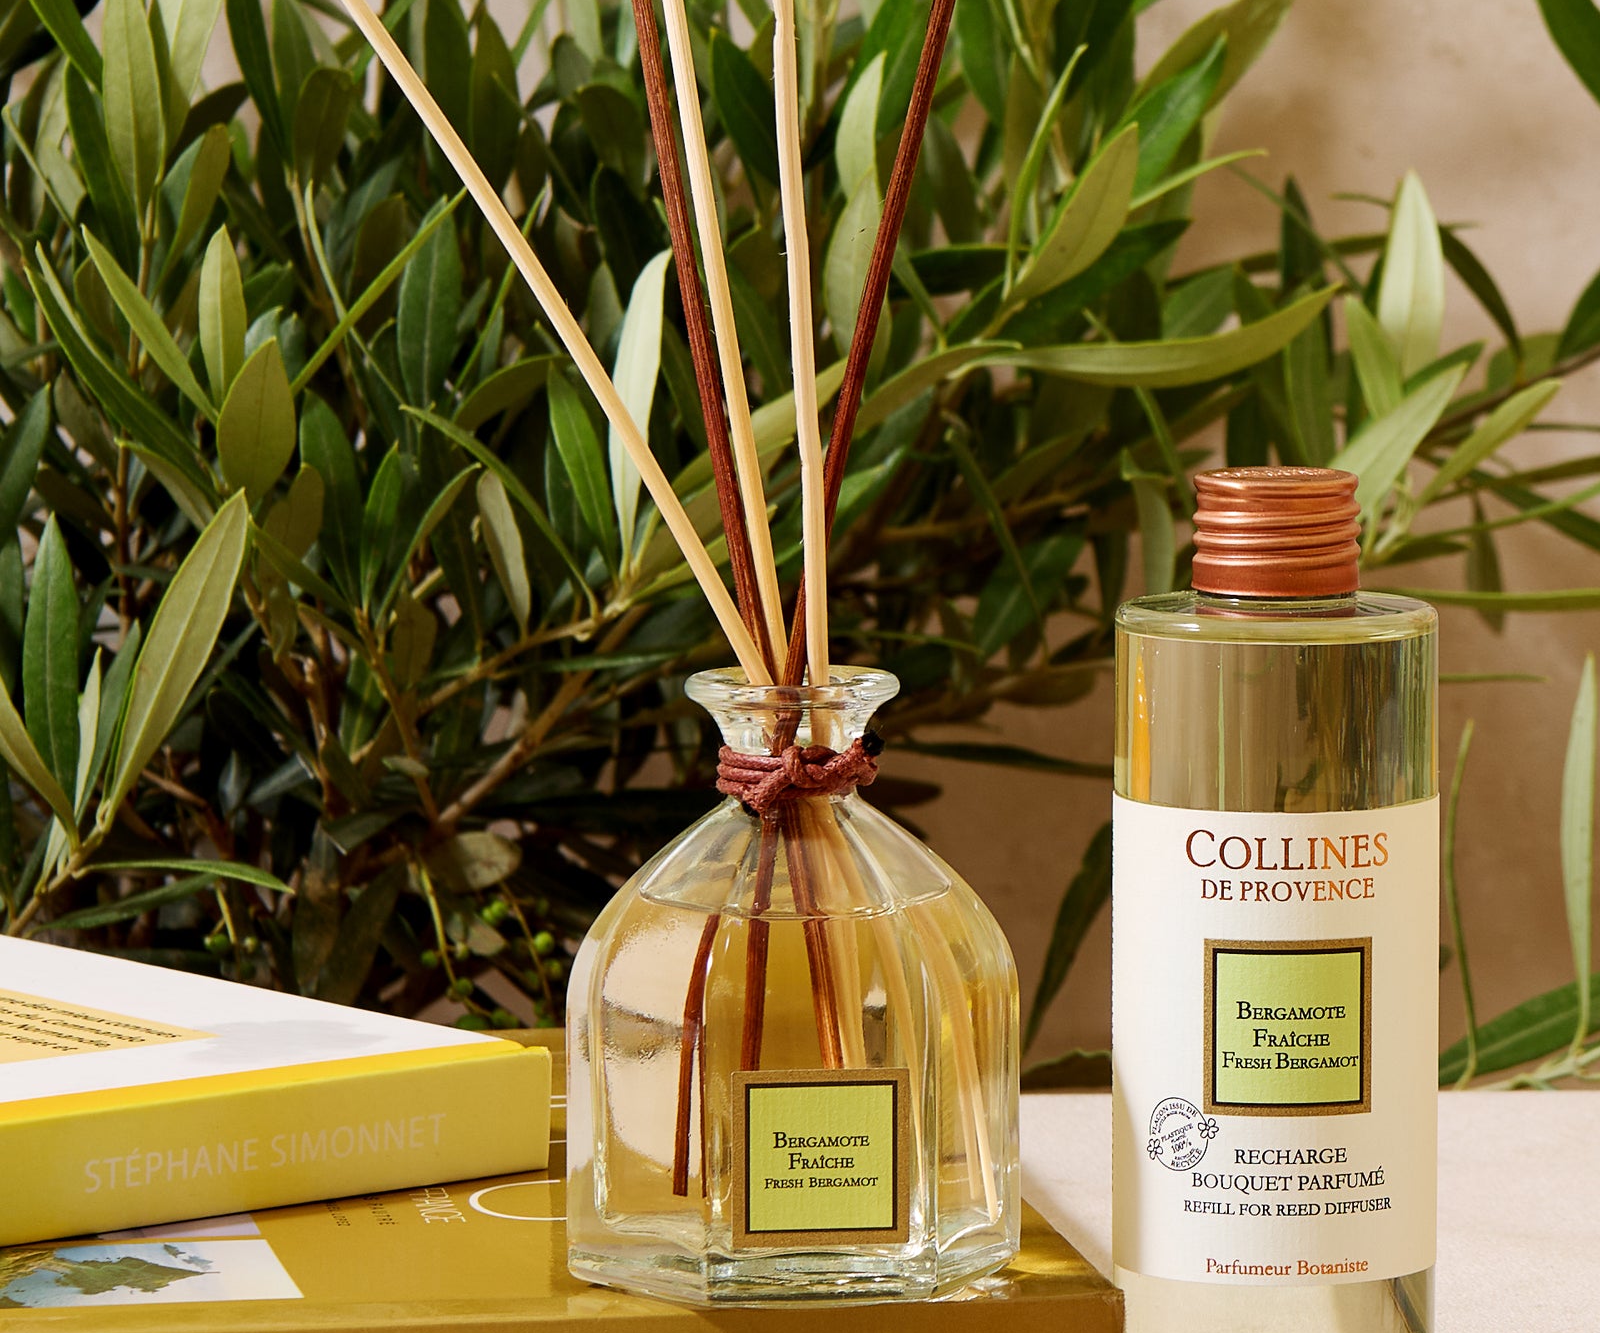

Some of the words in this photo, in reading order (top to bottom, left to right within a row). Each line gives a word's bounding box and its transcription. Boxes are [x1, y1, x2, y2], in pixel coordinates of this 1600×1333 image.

[1185, 829, 1389, 870] COLLINES
[1201, 878, 1233, 901] DE
[1240, 877, 1375, 902] PROVENCE
[1236, 1000, 1346, 1021] BERGAMOTE
[1222, 1051, 1272, 1070] FRESH
[1275, 1052, 1359, 1070] BERGAMOT
[772, 1131, 870, 1149] BERGAMOTE
[84, 1138, 260, 1193] STÉPHANE
[270, 1113, 447, 1167] SIMONNET
[1234, 1147, 1347, 1165] RECHARGE
[764, 1178, 804, 1189] FRESH
[809, 1177, 878, 1188] BERGAMOT
[1191, 1171, 1293, 1194] BOUQUET
[1298, 1166, 1385, 1191] PARFUMÉ
[1184, 1199, 1235, 1216] REFILL
[1239, 1203, 1272, 1216] FOR
[1275, 1203, 1321, 1216] REED
[1325, 1197, 1392, 1215] DIFFUSER
[1206, 1258, 1291, 1276] Parfumeur
[1297, 1258, 1369, 1276] Botaniste
